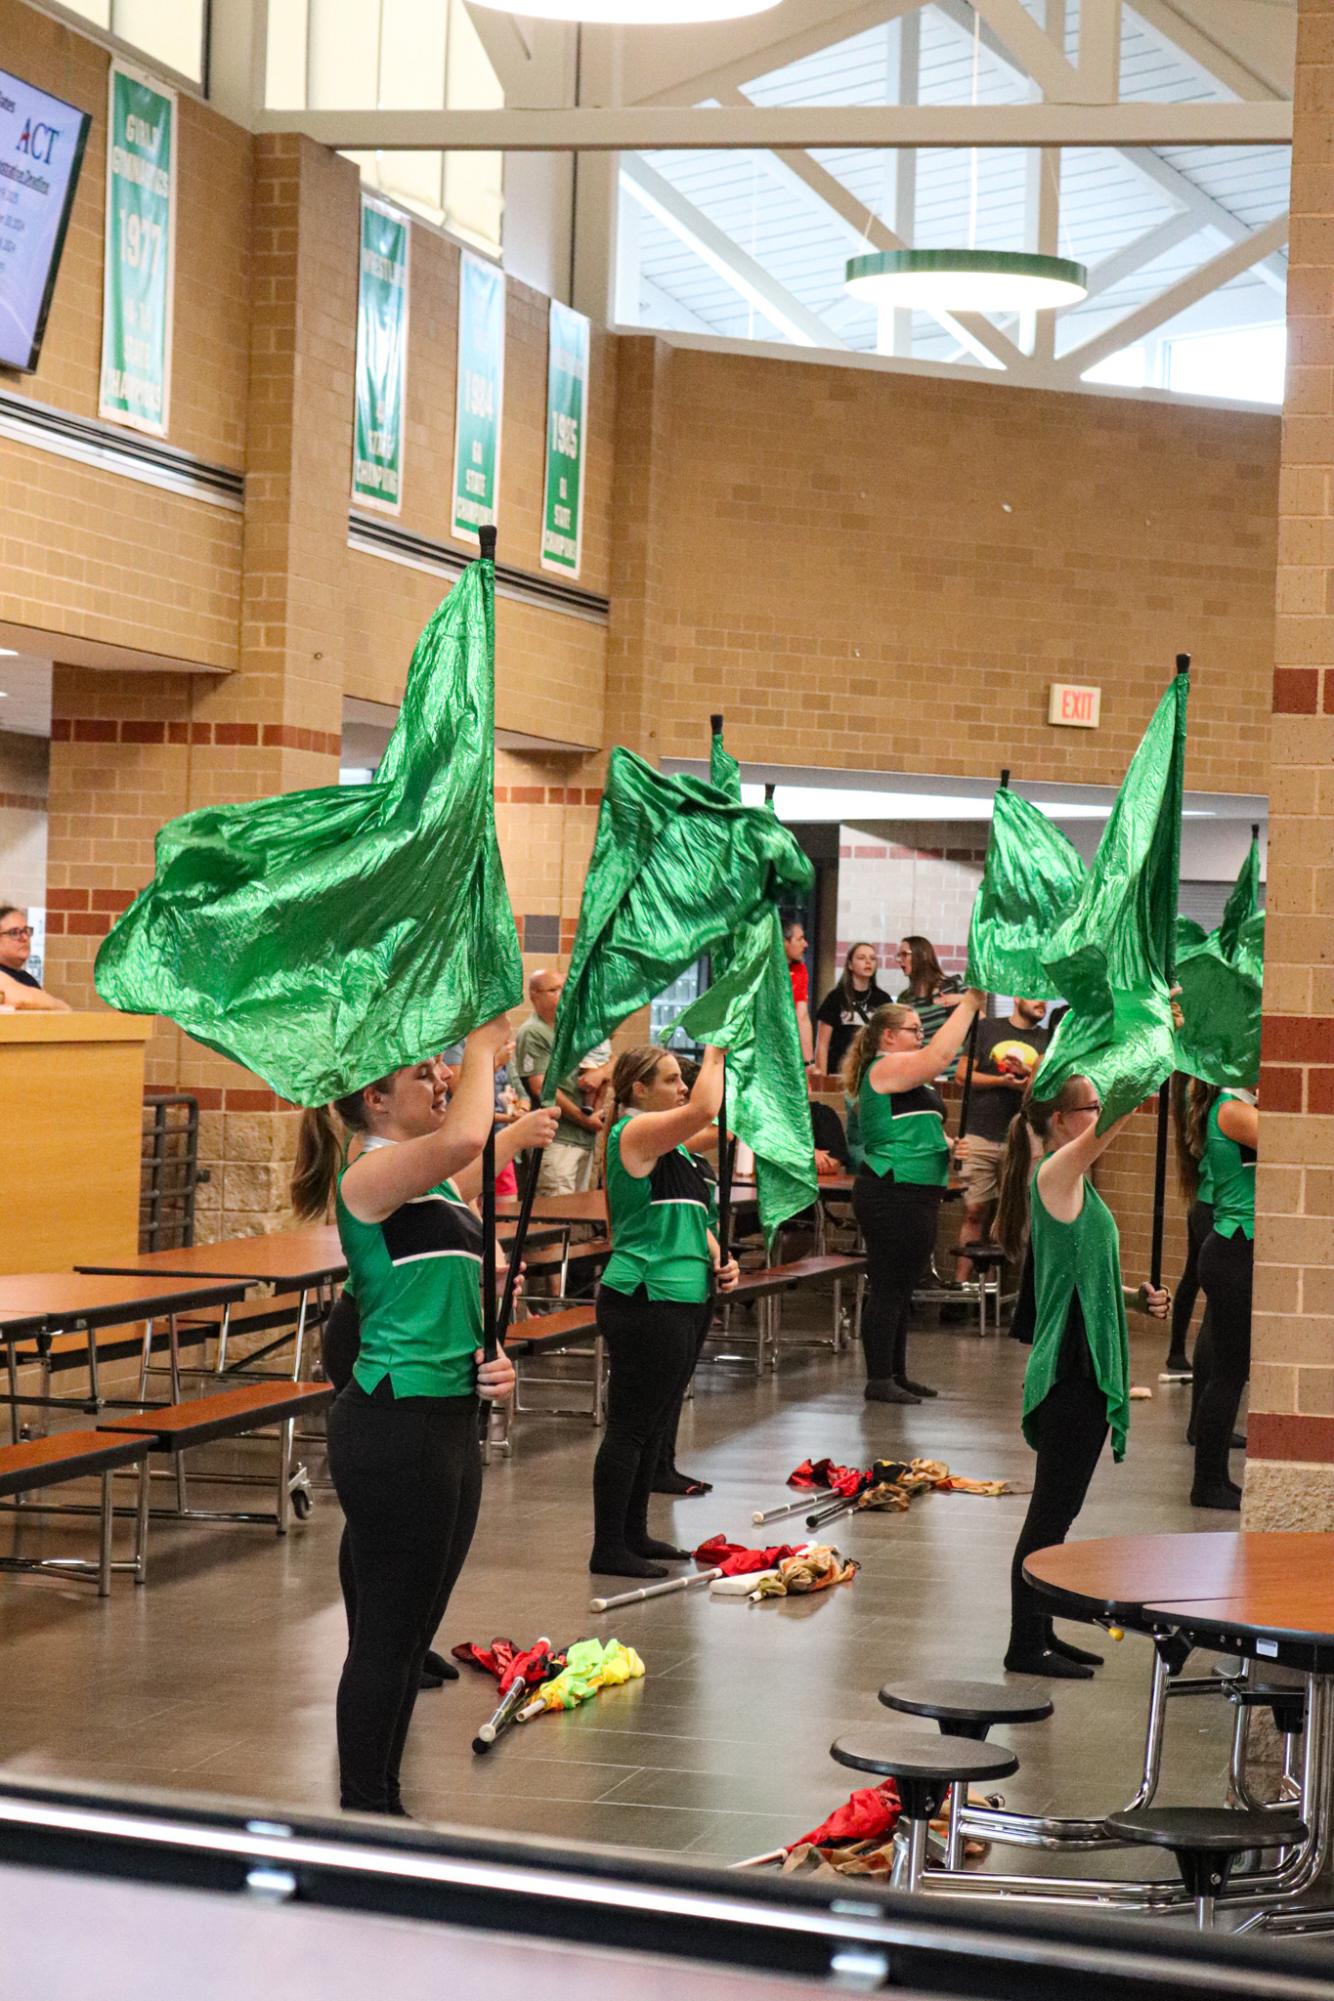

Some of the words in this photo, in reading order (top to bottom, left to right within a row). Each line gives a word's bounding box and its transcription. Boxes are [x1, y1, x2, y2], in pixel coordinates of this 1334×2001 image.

[16, 117, 60, 165] ACT
[119, 208, 161, 273] 1977
[1062, 690, 1095, 720] EXIT
